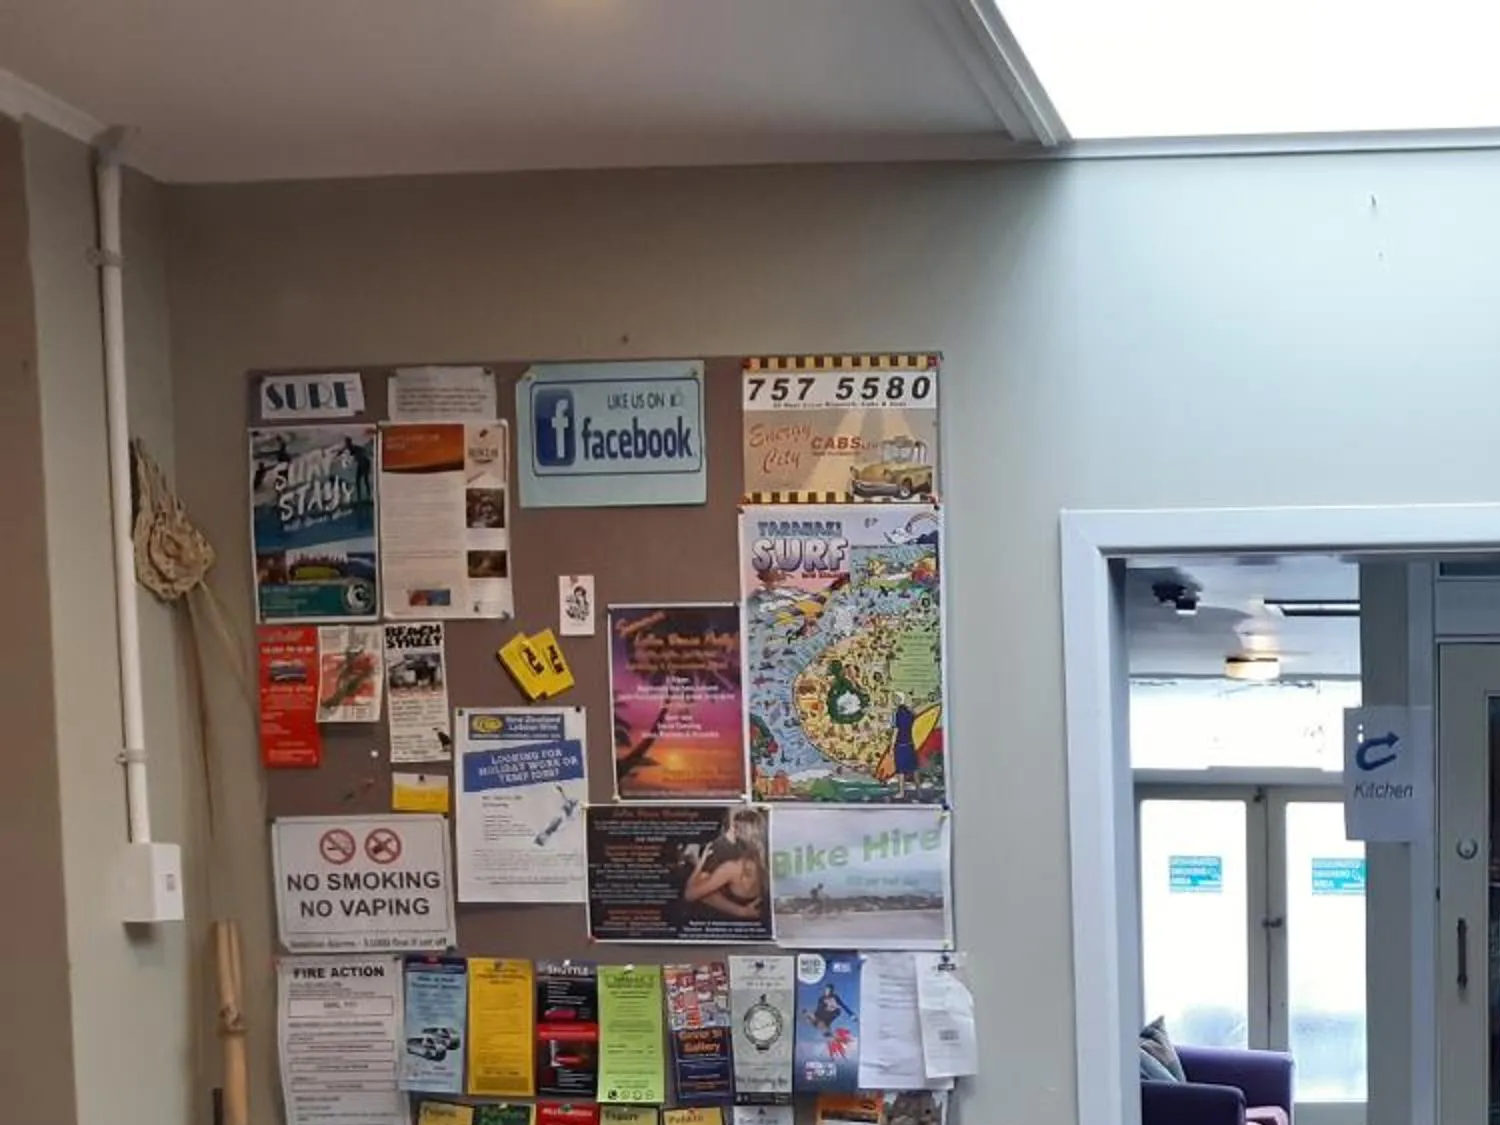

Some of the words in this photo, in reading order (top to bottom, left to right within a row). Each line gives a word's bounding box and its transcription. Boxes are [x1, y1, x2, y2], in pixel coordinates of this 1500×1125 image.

[747, 376, 816, 401] 757
[835, 375, 931, 400] 5580
[607, 393, 628, 410] LIKE
[631, 392, 645, 409] US
[647, 391, 665, 409] ON
[581, 416, 693, 459] facebook
[811, 436, 861, 450] CABS
[752, 537, 849, 572] SURF
[1353, 781, 1414, 799] Kitchen
[773, 844, 849, 879] Bike
[862, 828, 942, 863] Hire
[287, 874, 319, 891] NO
[327, 872, 441, 890] SMOKING
[301, 900, 332, 917] NO
[340, 898, 430, 917] VAPING
[293, 967, 326, 979] FIRE
[331, 966, 385, 978] ACTION
